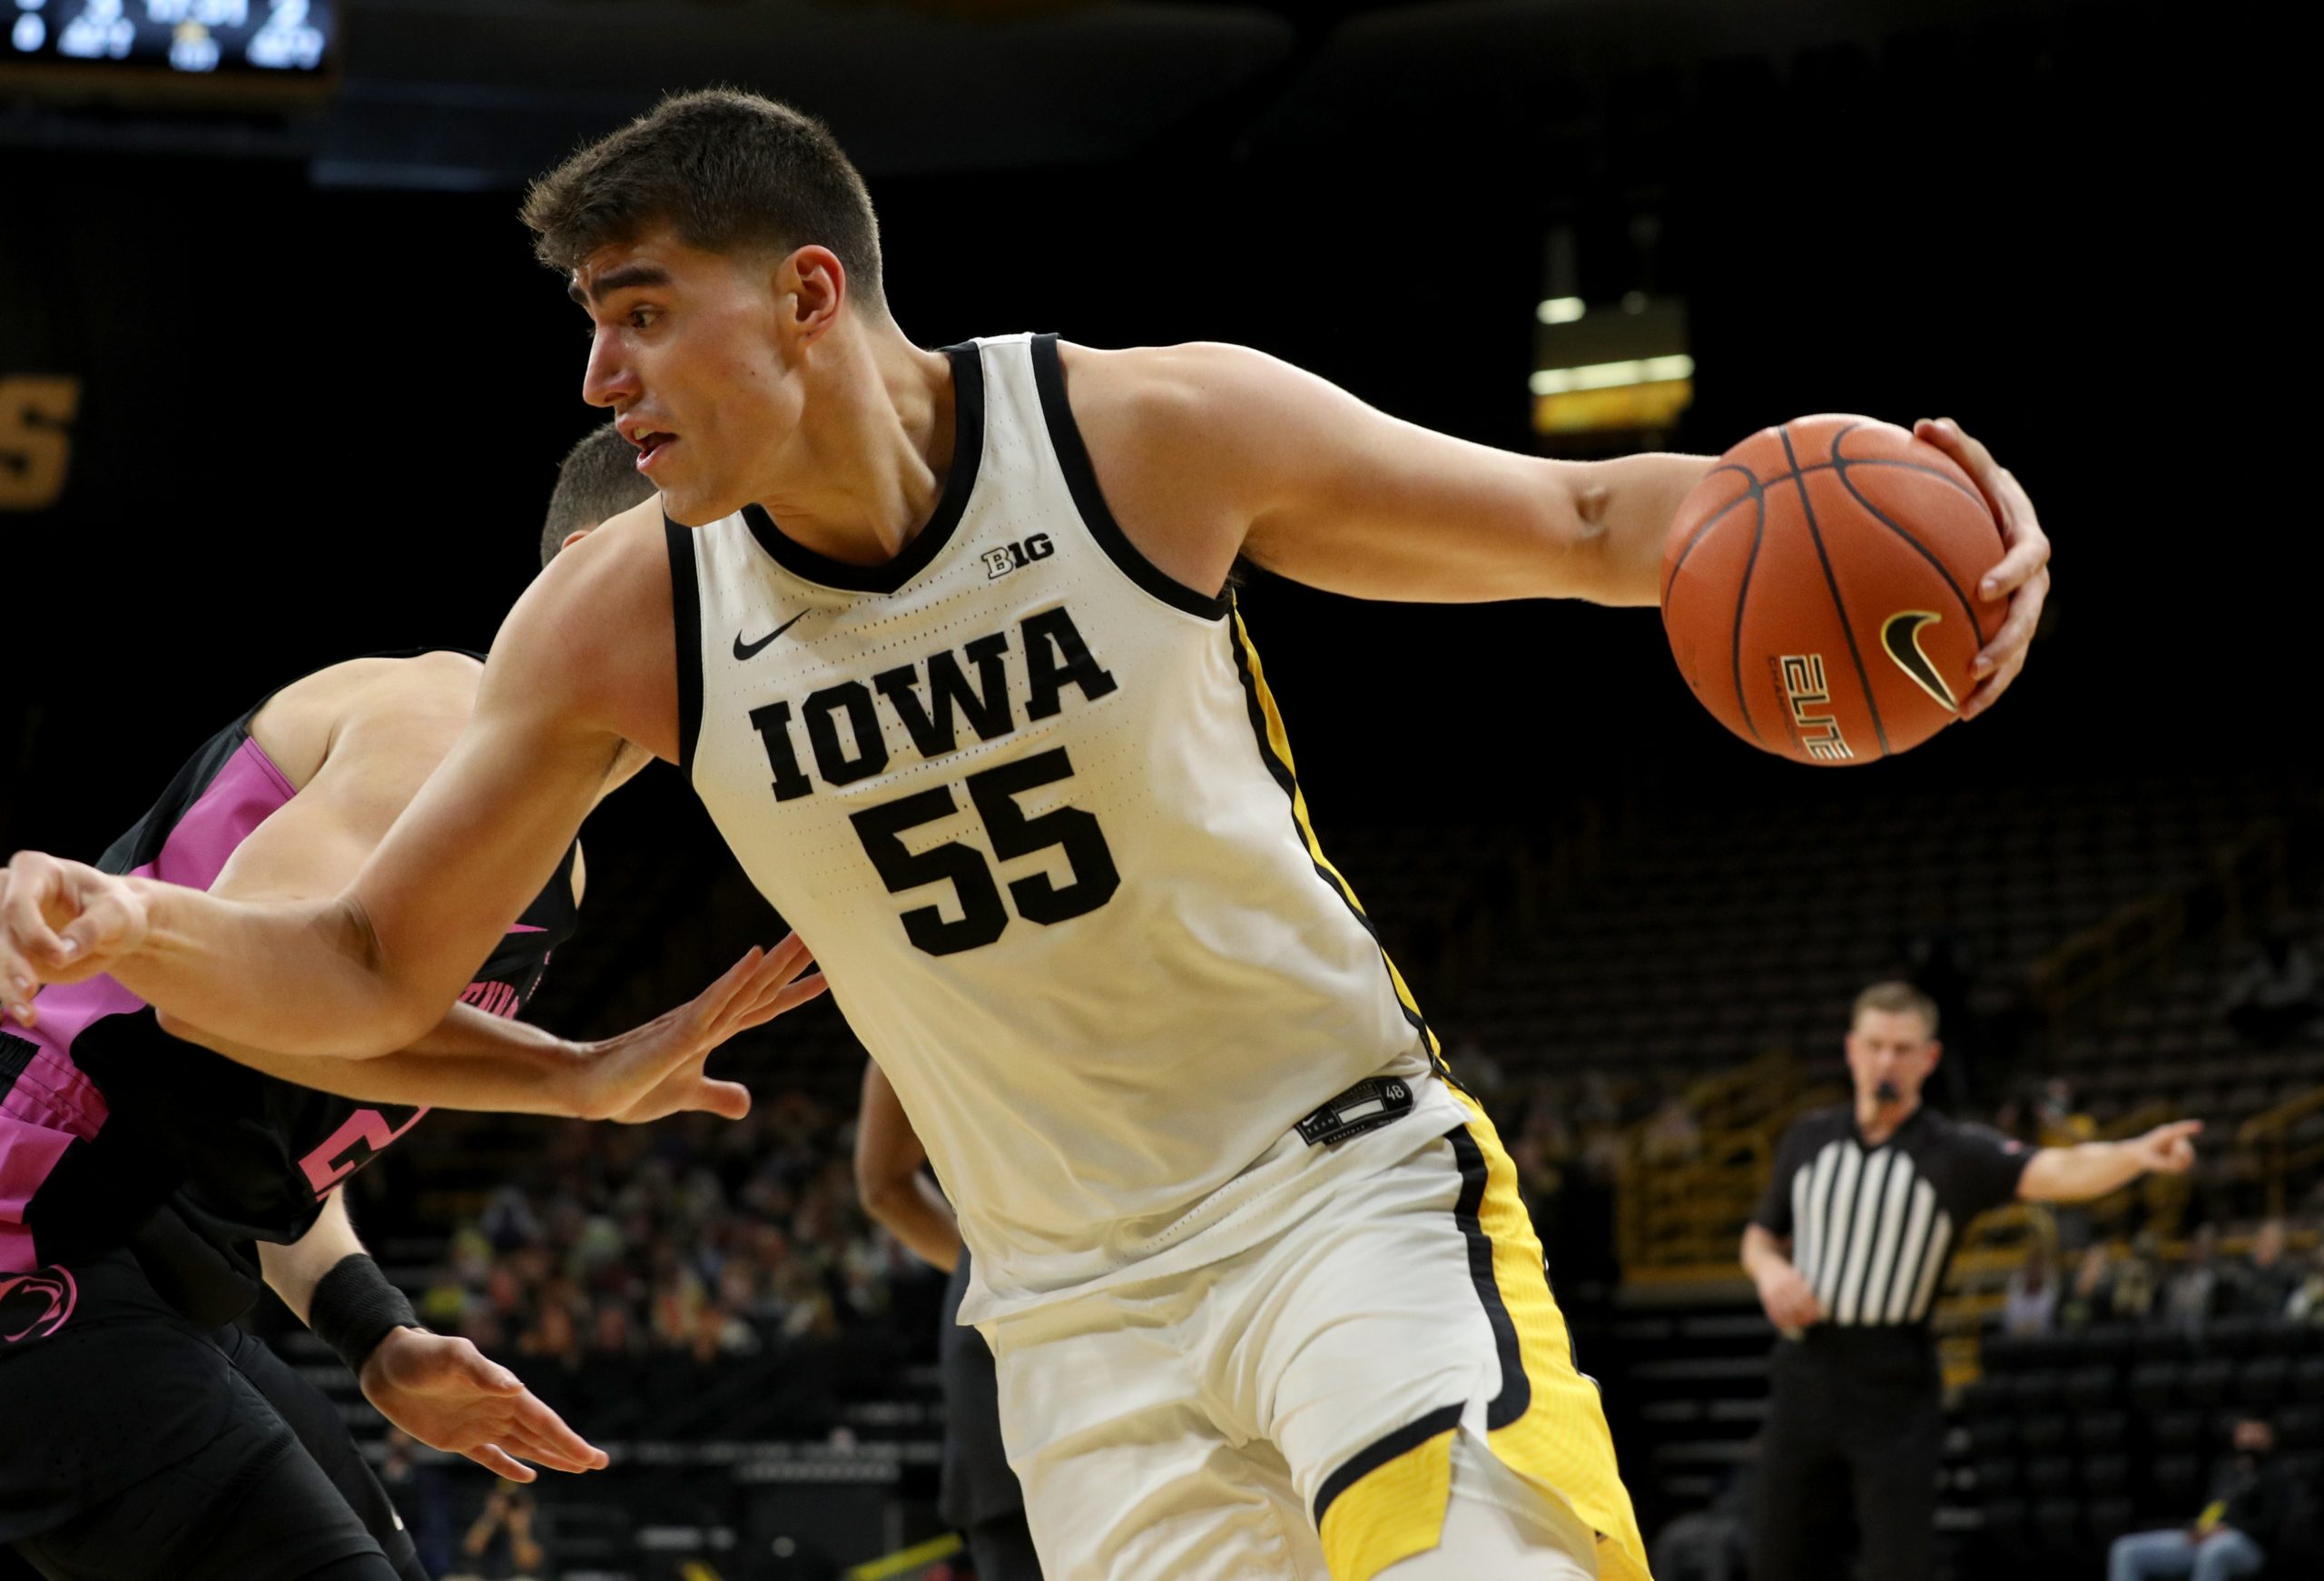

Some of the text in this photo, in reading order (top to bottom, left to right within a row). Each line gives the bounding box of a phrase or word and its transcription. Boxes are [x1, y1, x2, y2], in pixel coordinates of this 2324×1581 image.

[748, 606, 1118, 803] IOWA
[1780, 653, 1855, 760] ELITE
[848, 746, 1121, 957] 55
[1385, 1084, 1405, 1102] 48
